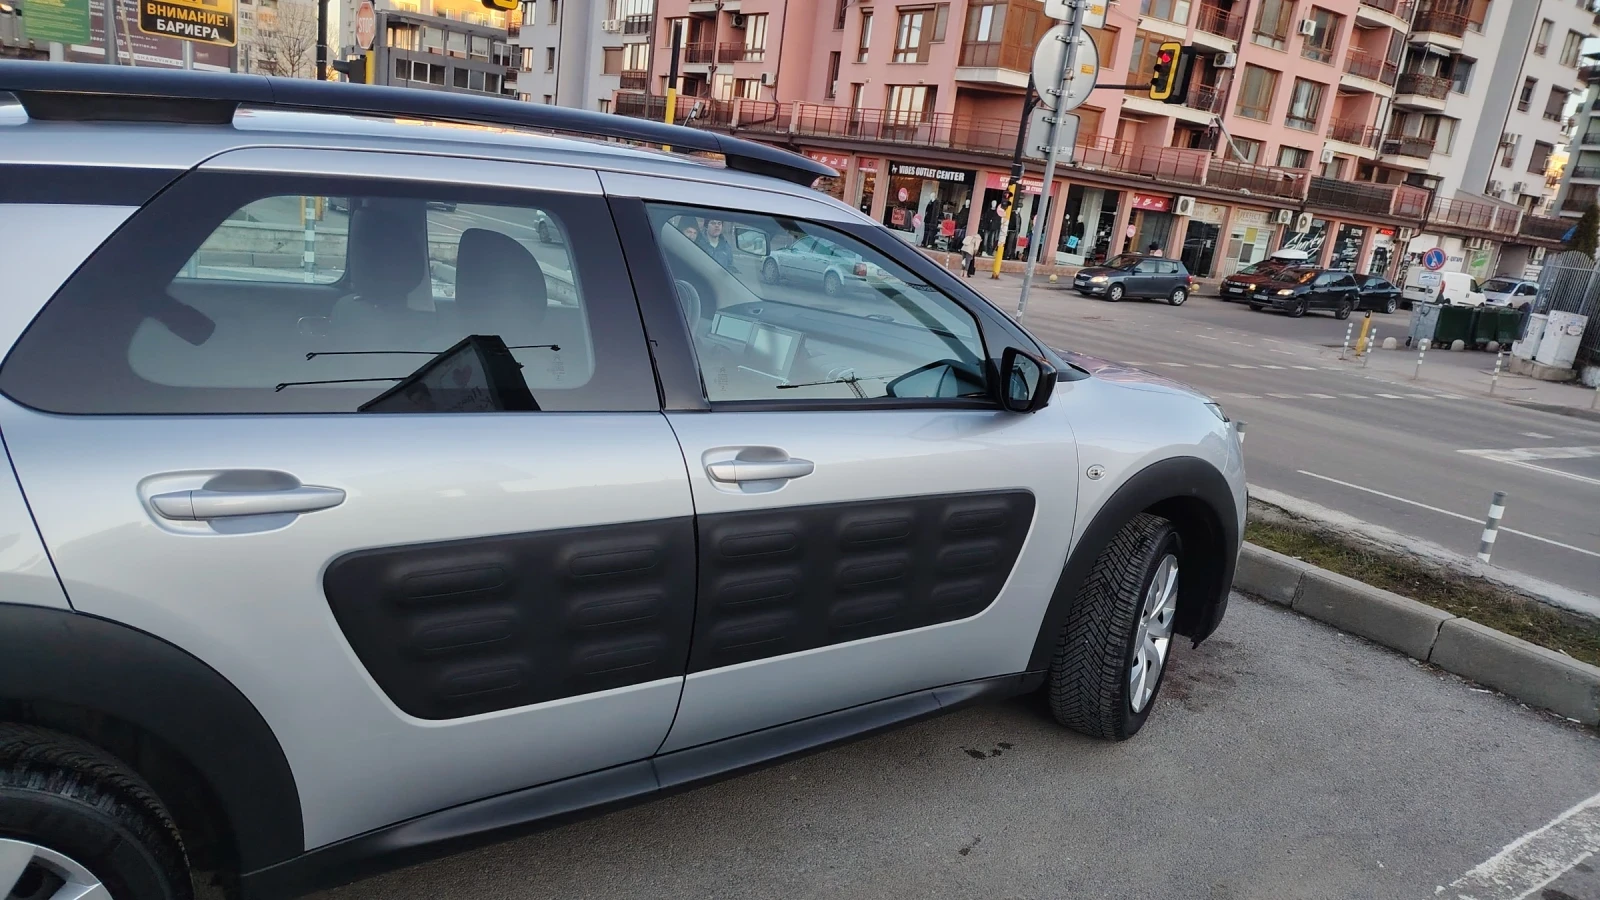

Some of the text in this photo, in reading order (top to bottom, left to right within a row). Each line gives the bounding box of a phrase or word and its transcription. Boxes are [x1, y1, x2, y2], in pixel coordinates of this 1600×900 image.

[147, 3, 229, 27] ВНИМАНИЕ!
[156, 18, 220, 39] БАРИЕРА
[358, 17, 373, 33] STOP
[899, 165, 965, 182] VIBES OUTLET CENTER
